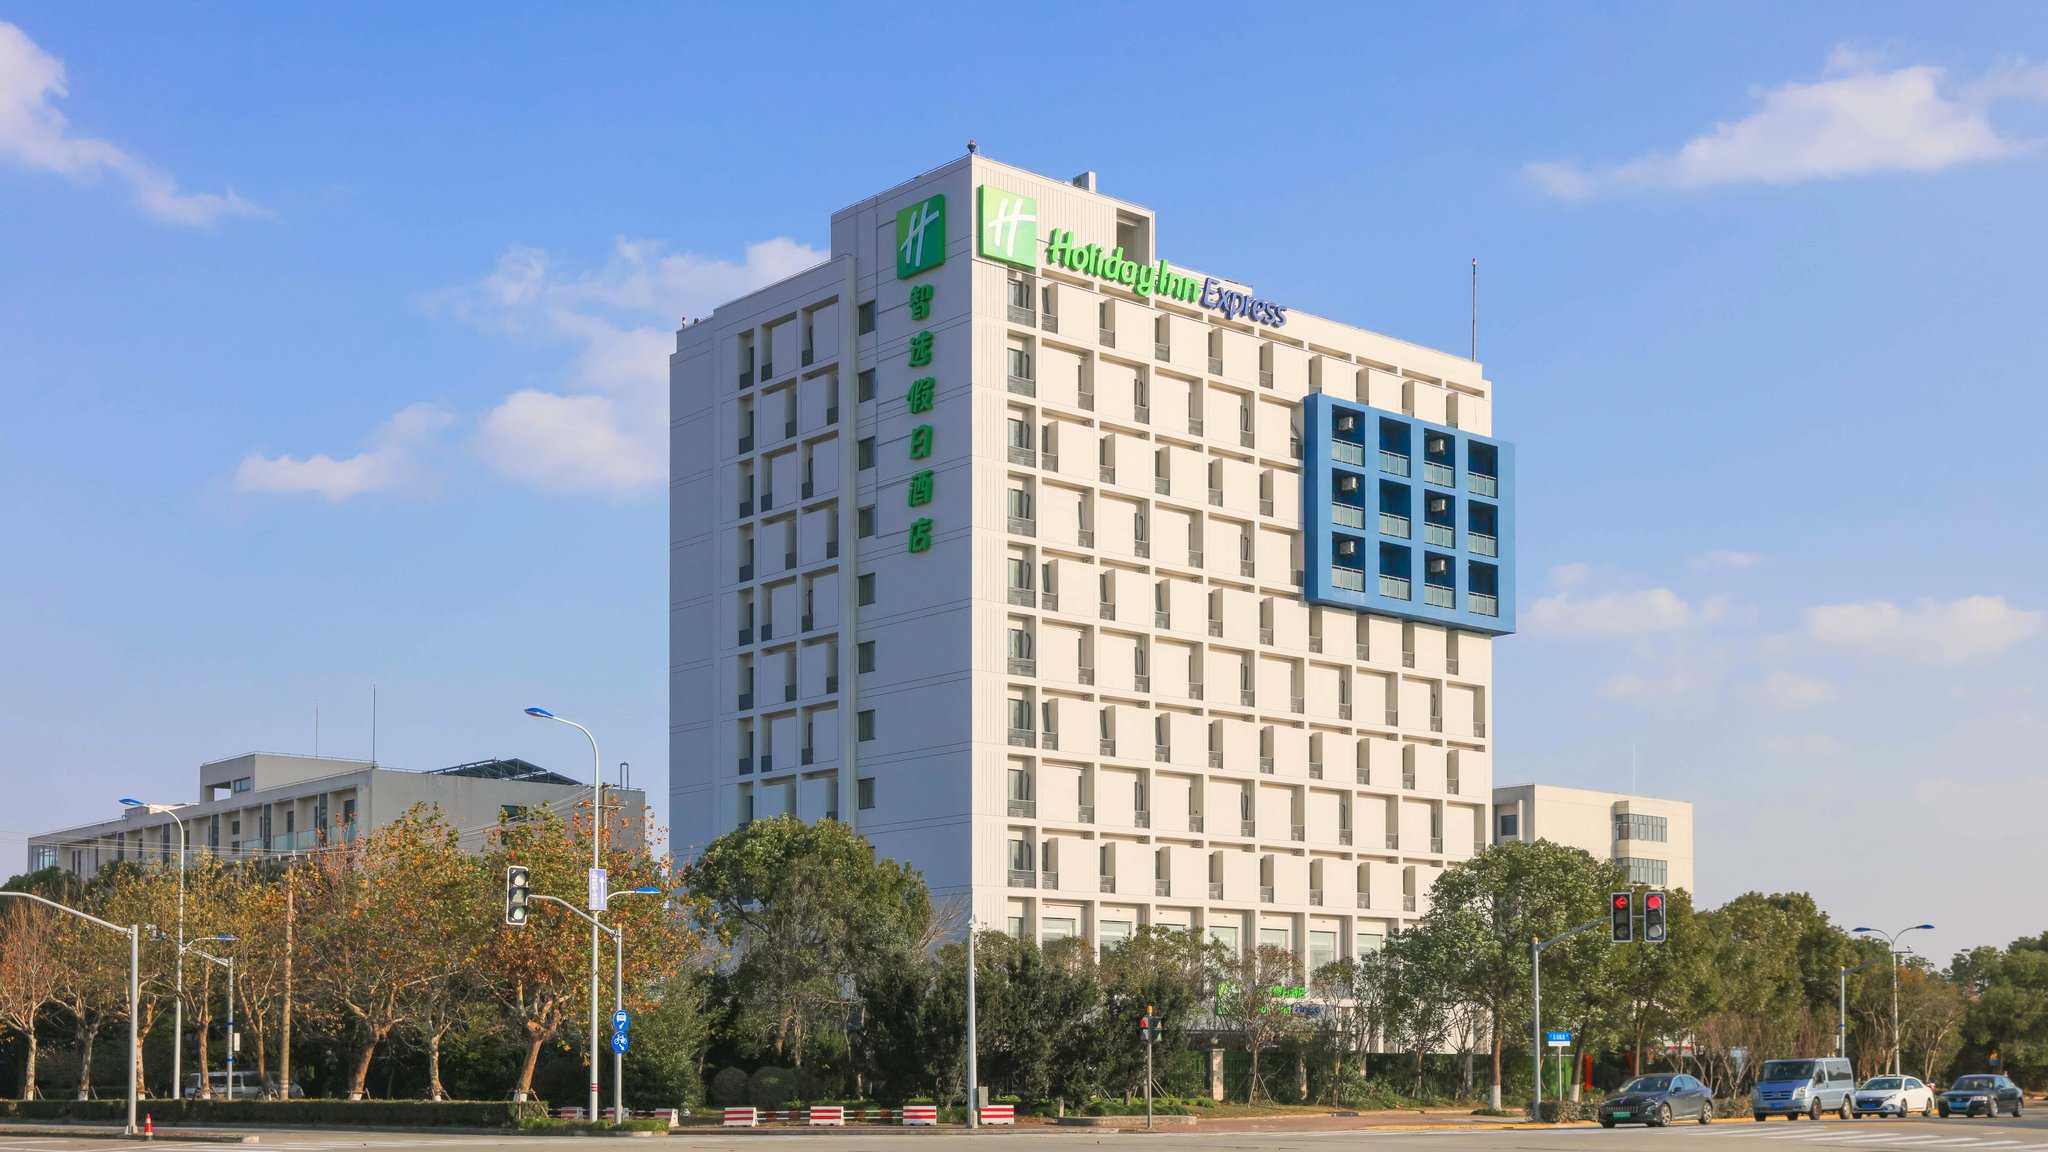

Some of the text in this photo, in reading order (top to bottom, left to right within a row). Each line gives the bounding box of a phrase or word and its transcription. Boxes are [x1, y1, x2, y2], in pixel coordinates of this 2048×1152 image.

[1045, 228, 1287, 328] Holiday Inn Express
[907, 285, 935, 554] 智选假日酒店
